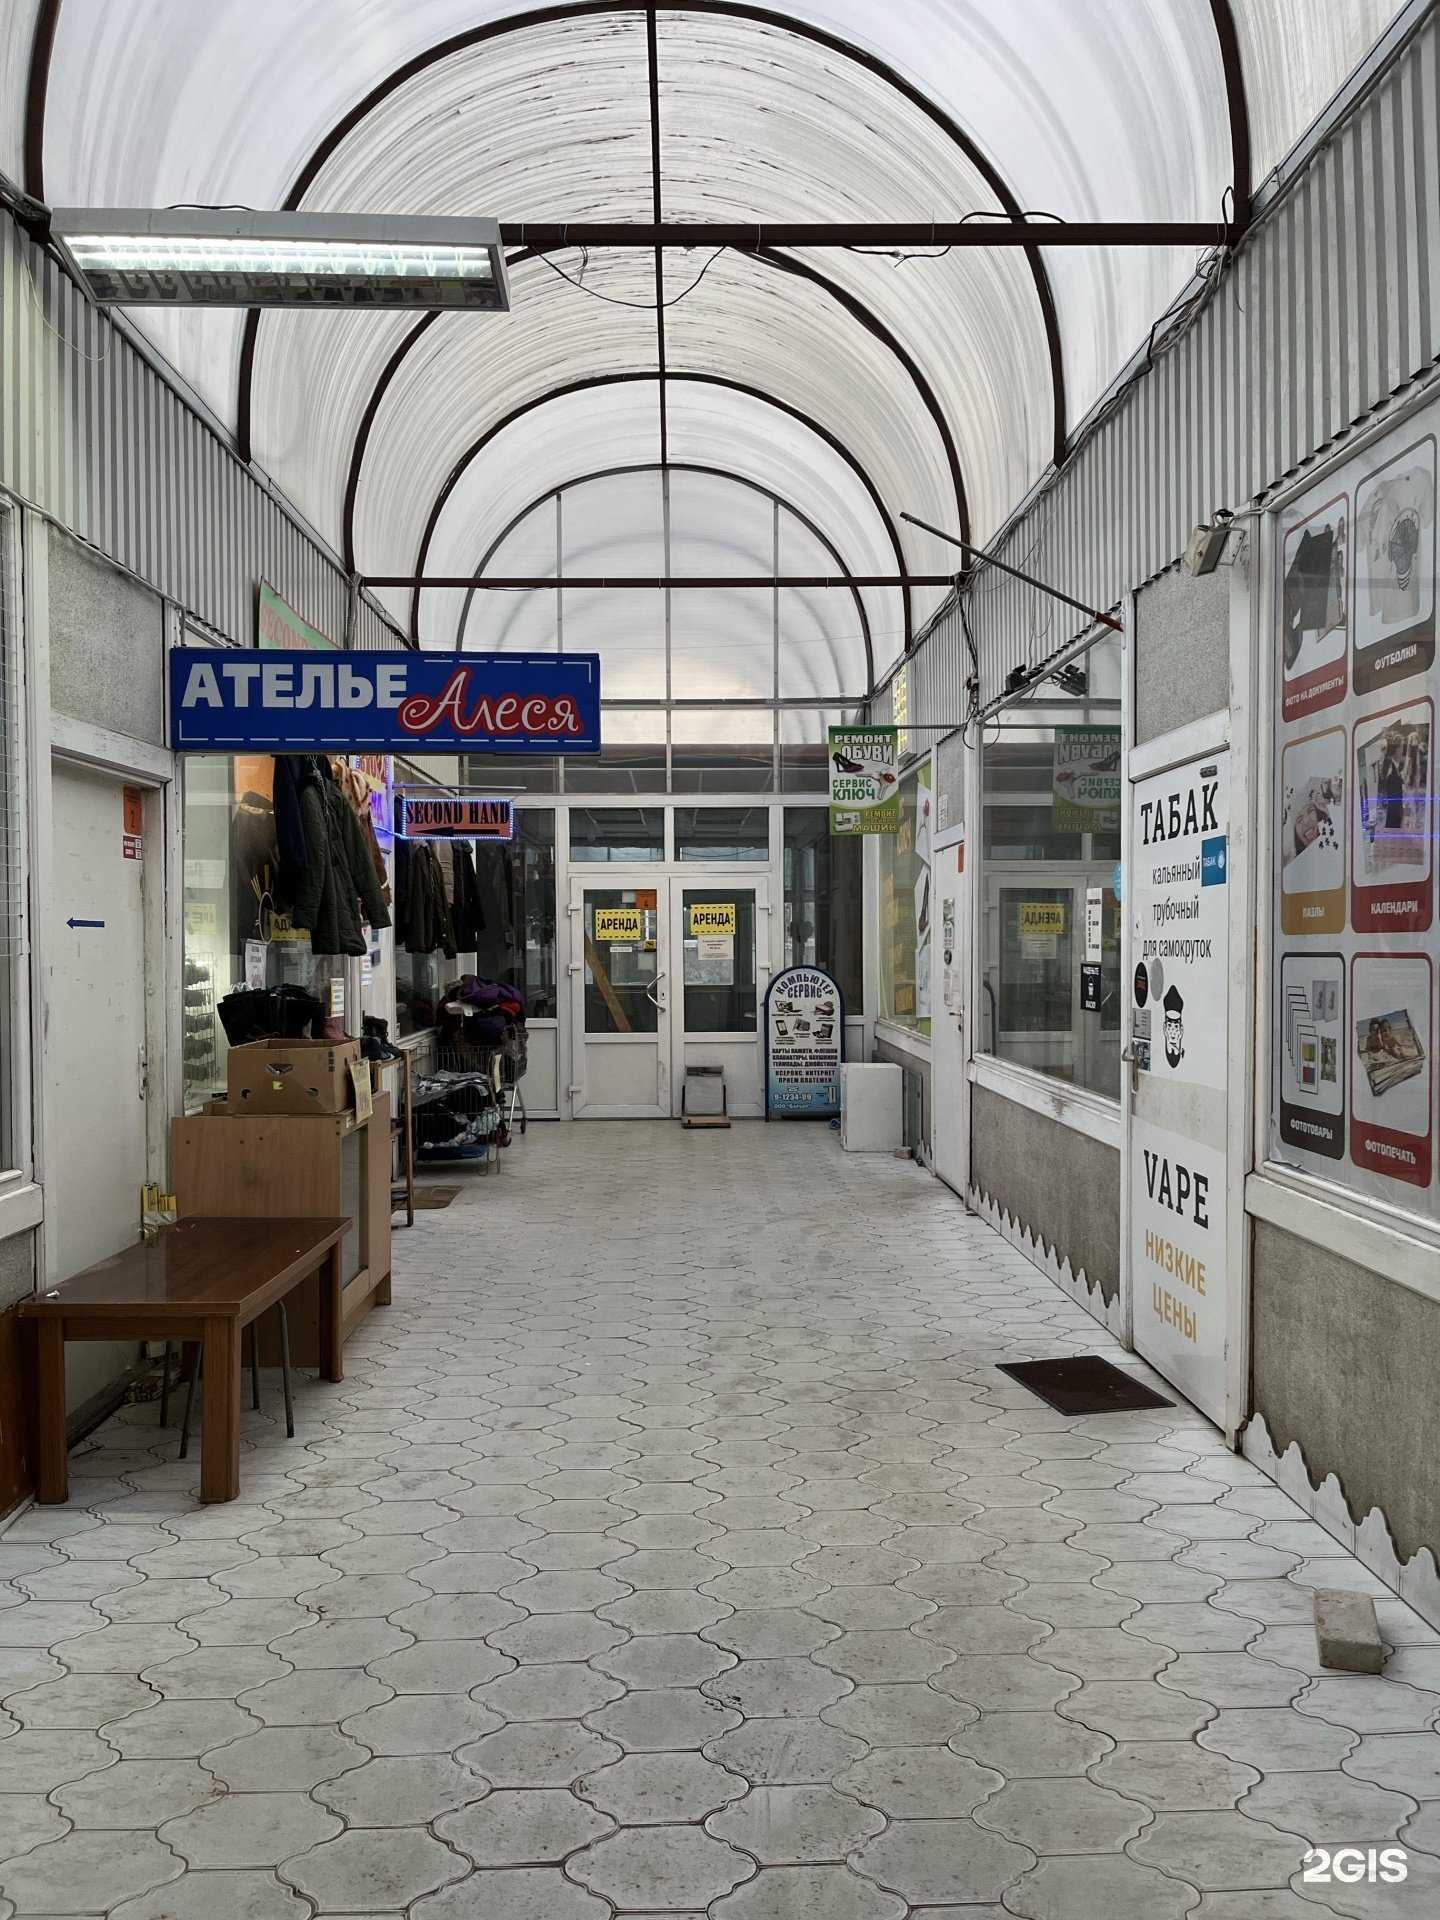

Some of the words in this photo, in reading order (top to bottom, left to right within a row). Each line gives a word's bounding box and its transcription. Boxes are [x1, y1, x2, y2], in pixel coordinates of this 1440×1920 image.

[1374, 643, 1417, 671] ФУТБОЛКИ
[181, 663, 409, 709] АТЕЛЬЕ
[1308, 675, 1345, 700] ДОКУМЕНТЫ
[402, 670, 579, 732] Алеся
[834, 734, 893, 744] РЕМОНТ
[841, 744, 894, 766] ОБУВИ
[832, 779, 872, 788] СЕРВИС
[832, 788, 876, 801] КЛЮЧ
[406, 800, 463, 824] SECOND
[469, 800, 510, 824] HAND
[1140, 781, 1218, 845] ТАБАК
[1152, 855, 1201, 887] кальянный
[693, 912, 731, 926] АРЕНДА
[1152, 894, 1199, 927] трубочный
[1302, 905, 1325, 919] ПАЗЛЫ
[1370, 900, 1418, 915] КАЛЕНДАРИ
[600, 918, 638, 931] АРЕНДА
[1143, 938, 1157, 961] для
[1158, 938, 1211, 963] самокруток
[775, 973, 834, 996] КОМПЬЮТЕР
[787, 983, 822, 999] СЕРВИС
[1290, 1117, 1333, 1140] ФОТОТОВАРЫ
[1365, 1138, 1416, 1165] ФОТОПЕЧАТЬ
[1143, 1149, 1209, 1230] VAPE
[1145, 1228, 1206, 1297] НИЗКИЕ
[1152, 1282, 1197, 1343] ЦЕНЫ
